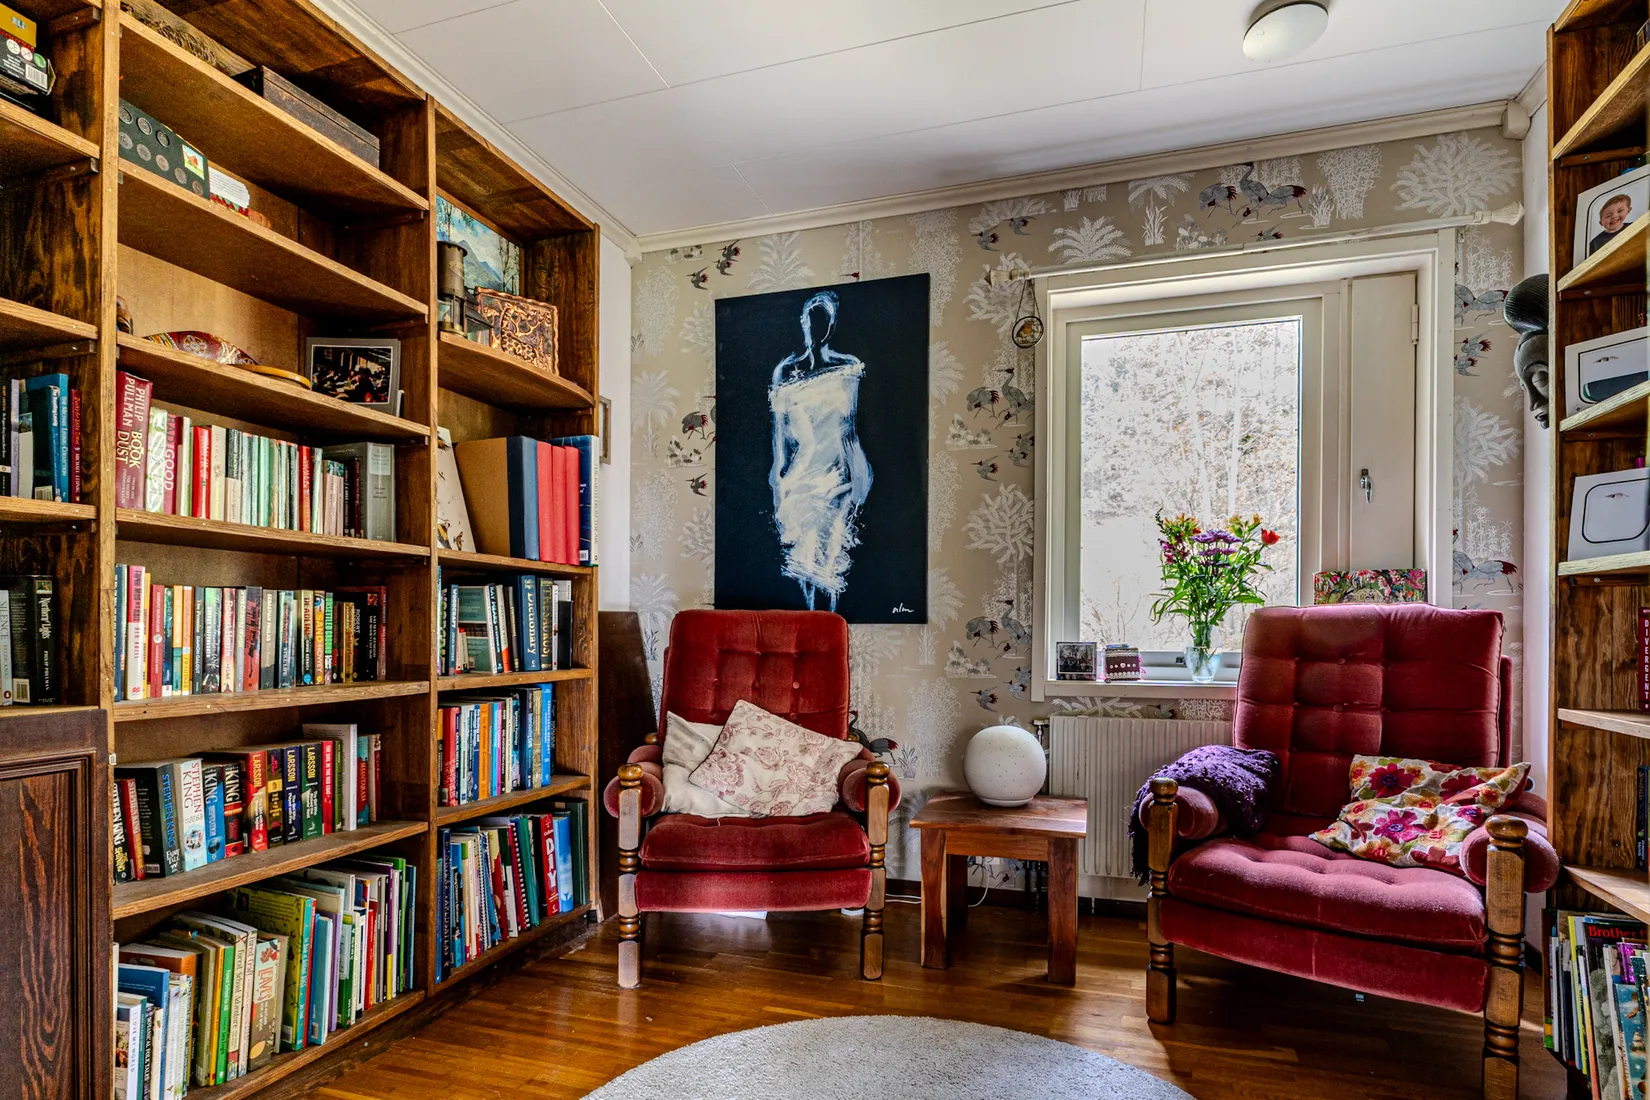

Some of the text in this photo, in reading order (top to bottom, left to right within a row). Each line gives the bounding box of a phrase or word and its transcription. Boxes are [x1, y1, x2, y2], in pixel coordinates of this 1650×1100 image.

[122, 376, 135, 427] PULLMAN
[135, 388, 146, 422] PHILIP
[166, 416, 176, 442] BAD
[116, 430, 129, 464] DUST
[130, 431, 142, 469] BOOK
[164, 449, 175, 491] GOOD
[0, 601, 9, 640] SILENCE
[38, 597, 51, 621] Northern
[39, 620, 51, 639] Lights
[316, 614, 325, 643] SAND
[252, 754, 262, 787] LARSSON
[287, 750, 295, 782] LARSSON
[308, 747, 316, 779] LARSSON
[128, 780, 138, 815] STEPHEN
[162, 774, 173, 820] STEPHEN
[183, 771, 193, 808] KING
[191, 762, 202, 813] STEPHEN
[205, 772, 218, 804] KING
[225, 770, 240, 802] KING
[114, 821, 125, 845] KING
[166, 821, 176, 848] KING
[115, 847, 125, 872] SHINING
[546, 838, 556, 888] DIY
[248, 936, 256, 957] Forest
[1587, 925, 1636, 938] Brother
[232, 949, 245, 1029] Forest School Adventure
[258, 966, 274, 1002] LEAVES
[132, 1036, 136, 1046] MY
